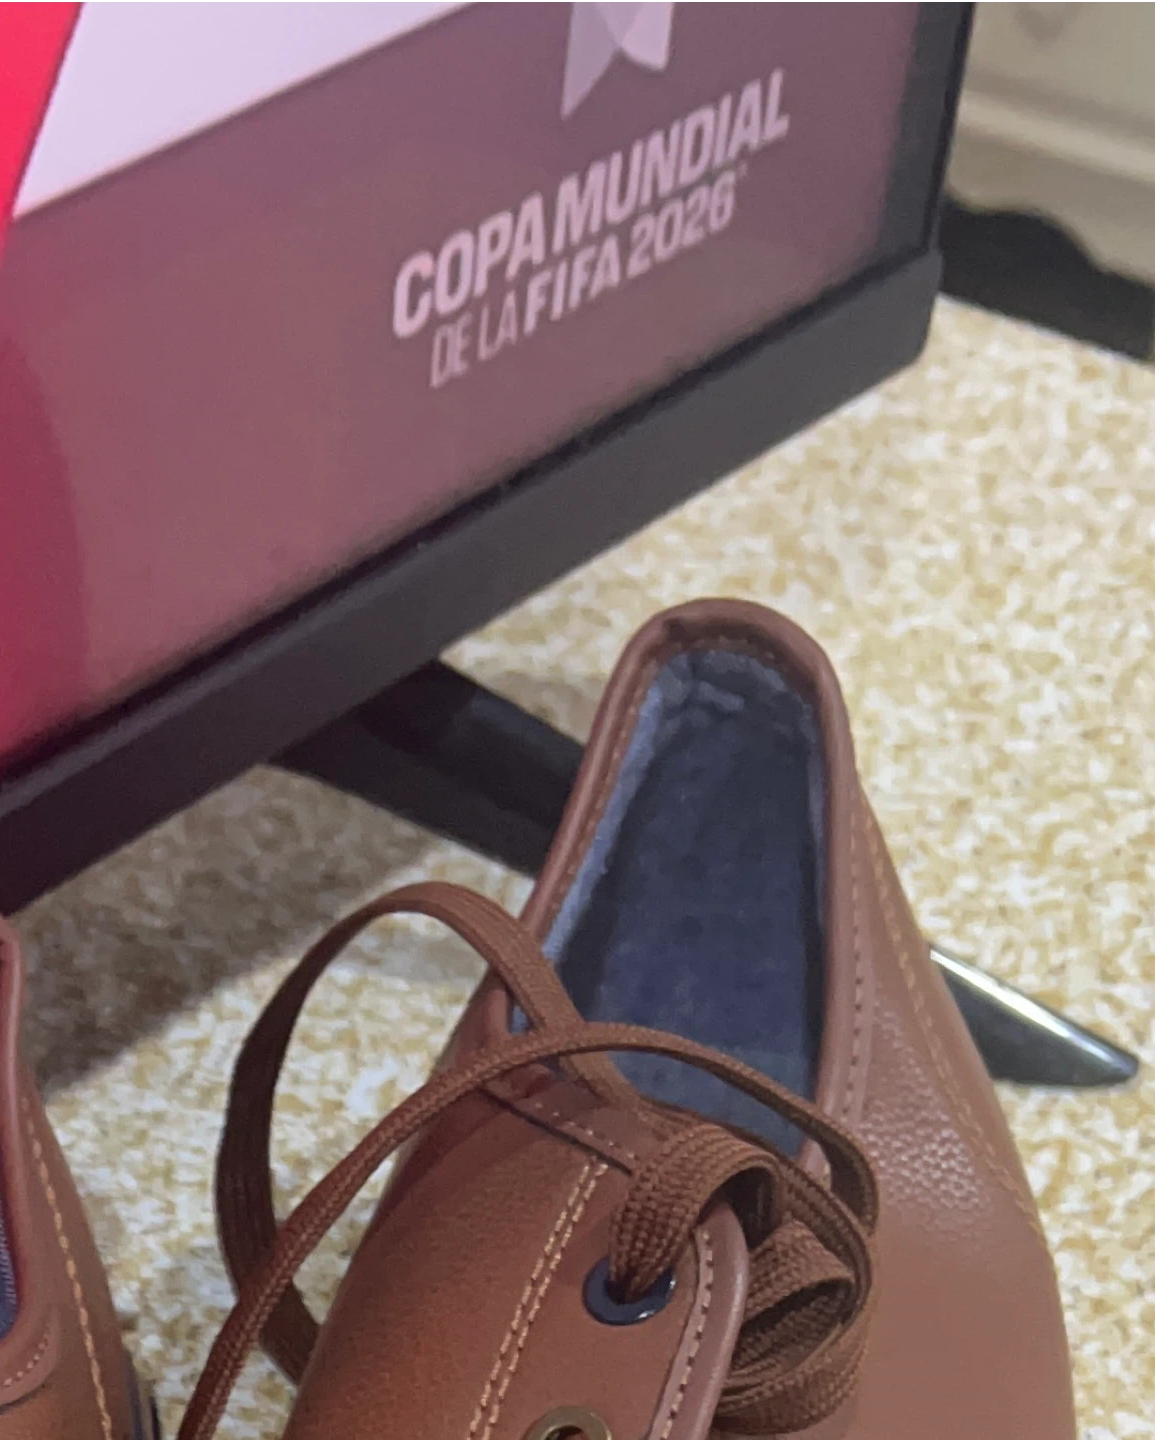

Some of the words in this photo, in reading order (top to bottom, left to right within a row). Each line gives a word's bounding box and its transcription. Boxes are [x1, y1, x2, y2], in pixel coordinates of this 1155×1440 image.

[392, 192, 545, 338] COPA
[553, 68, 790, 253] MUNDIAL
[430, 313, 473, 388] DE
[478, 290, 518, 361] LA
[524, 234, 621, 336] FIFA
